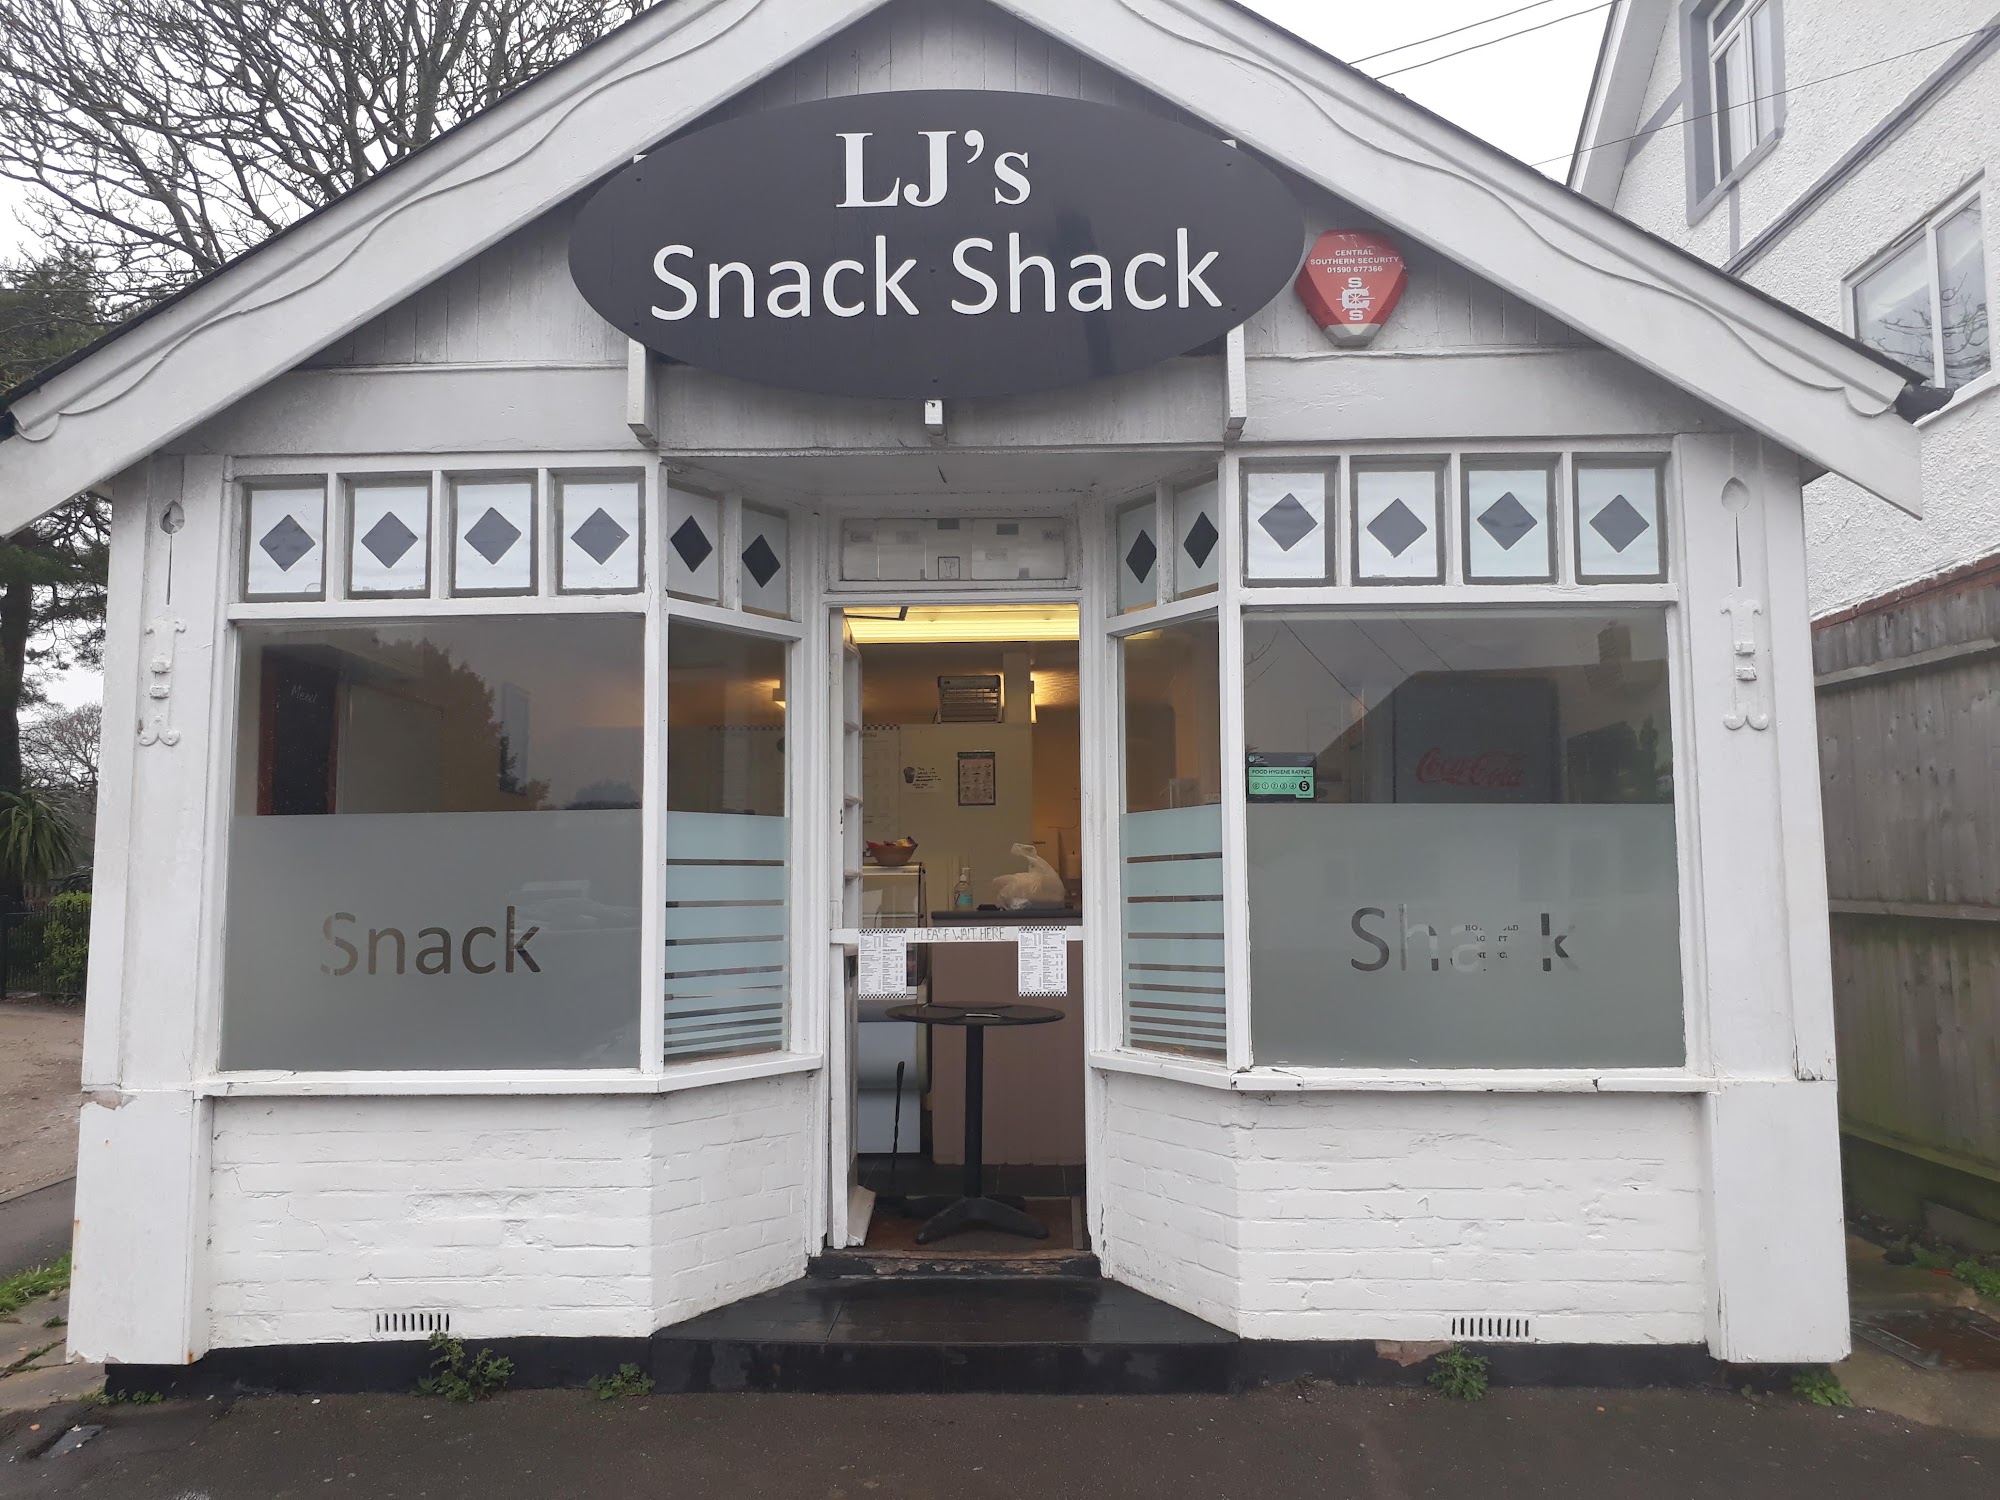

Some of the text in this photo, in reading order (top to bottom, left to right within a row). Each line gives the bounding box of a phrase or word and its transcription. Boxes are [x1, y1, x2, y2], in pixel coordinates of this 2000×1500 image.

[650, 227, 1223, 321] Snack Shack
[1357, 256, 1399, 264] SECURITY
[320, 905, 541, 976] Snack
[913, 926, 1006, 941] PLEASE WAIT HERE
[1350, 904, 1580, 972] Shak
